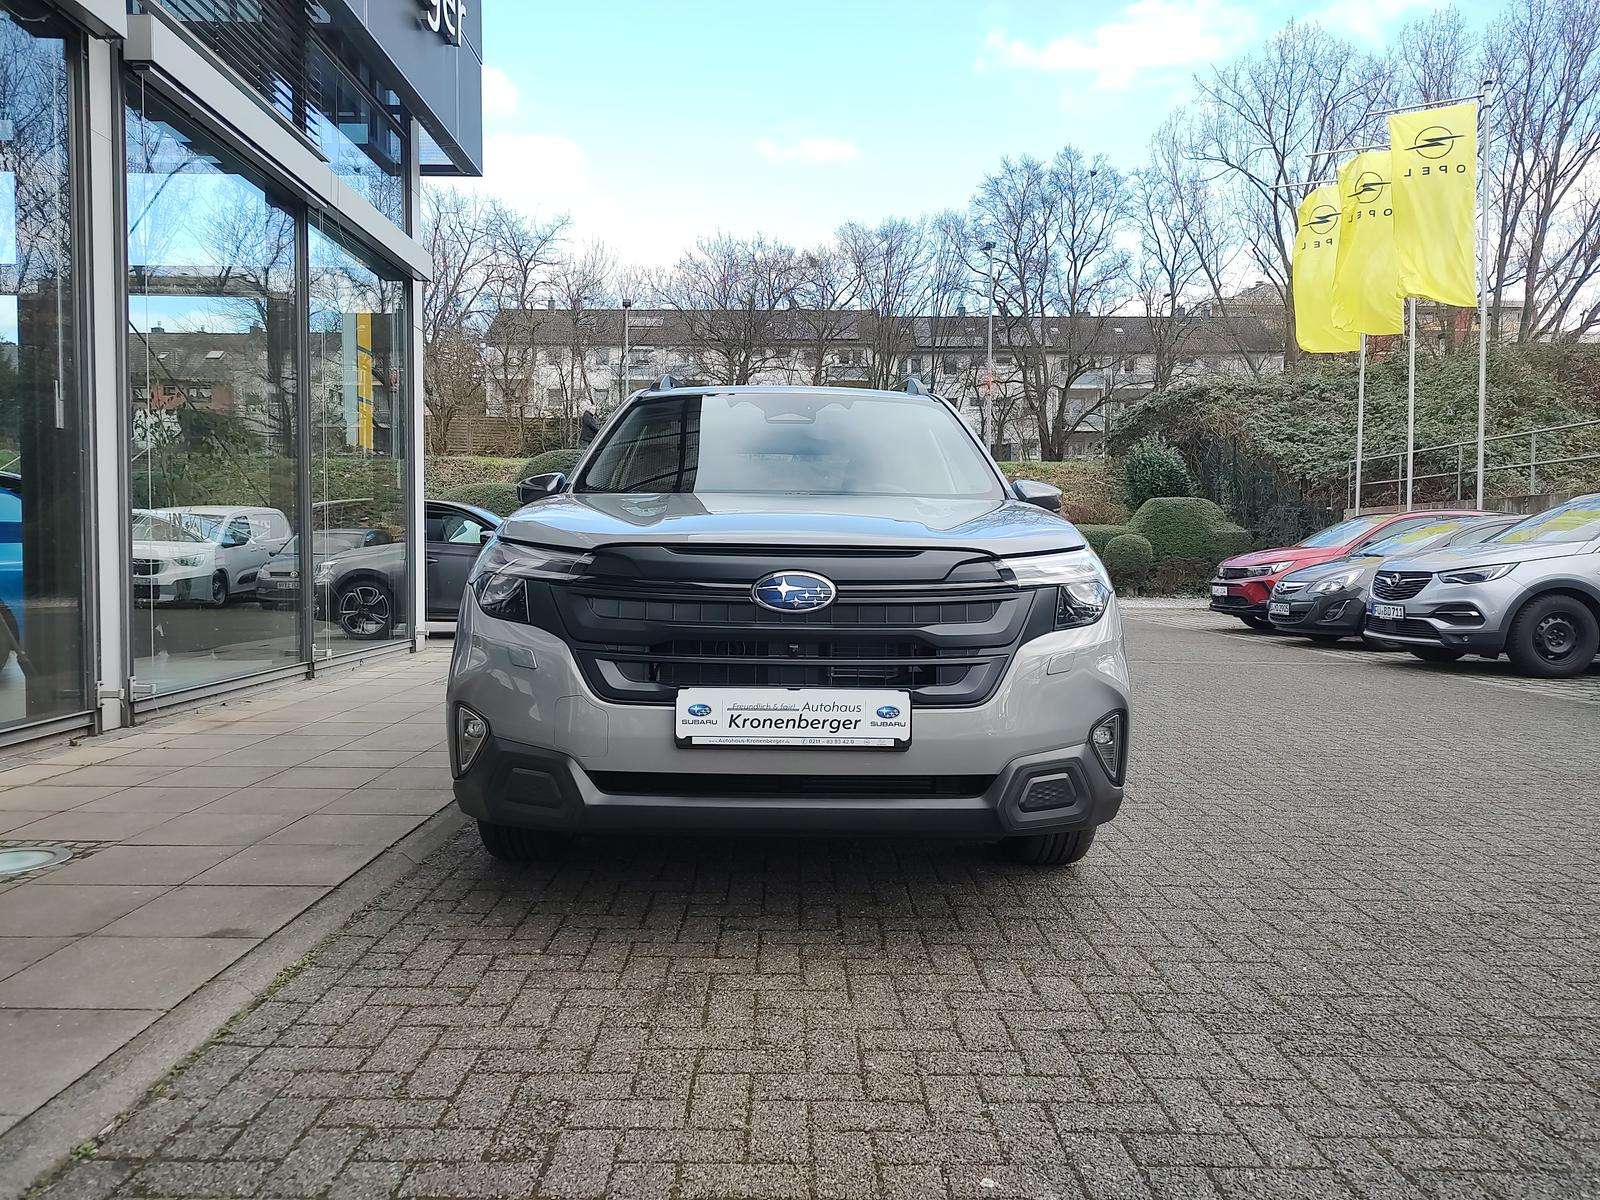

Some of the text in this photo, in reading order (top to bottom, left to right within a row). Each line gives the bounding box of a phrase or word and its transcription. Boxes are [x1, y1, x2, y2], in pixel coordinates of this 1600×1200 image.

[801, 701, 862, 713] Autohaus
[728, 713, 861, 734] Kronenberger
[870, 720, 906, 728] SUBARU
